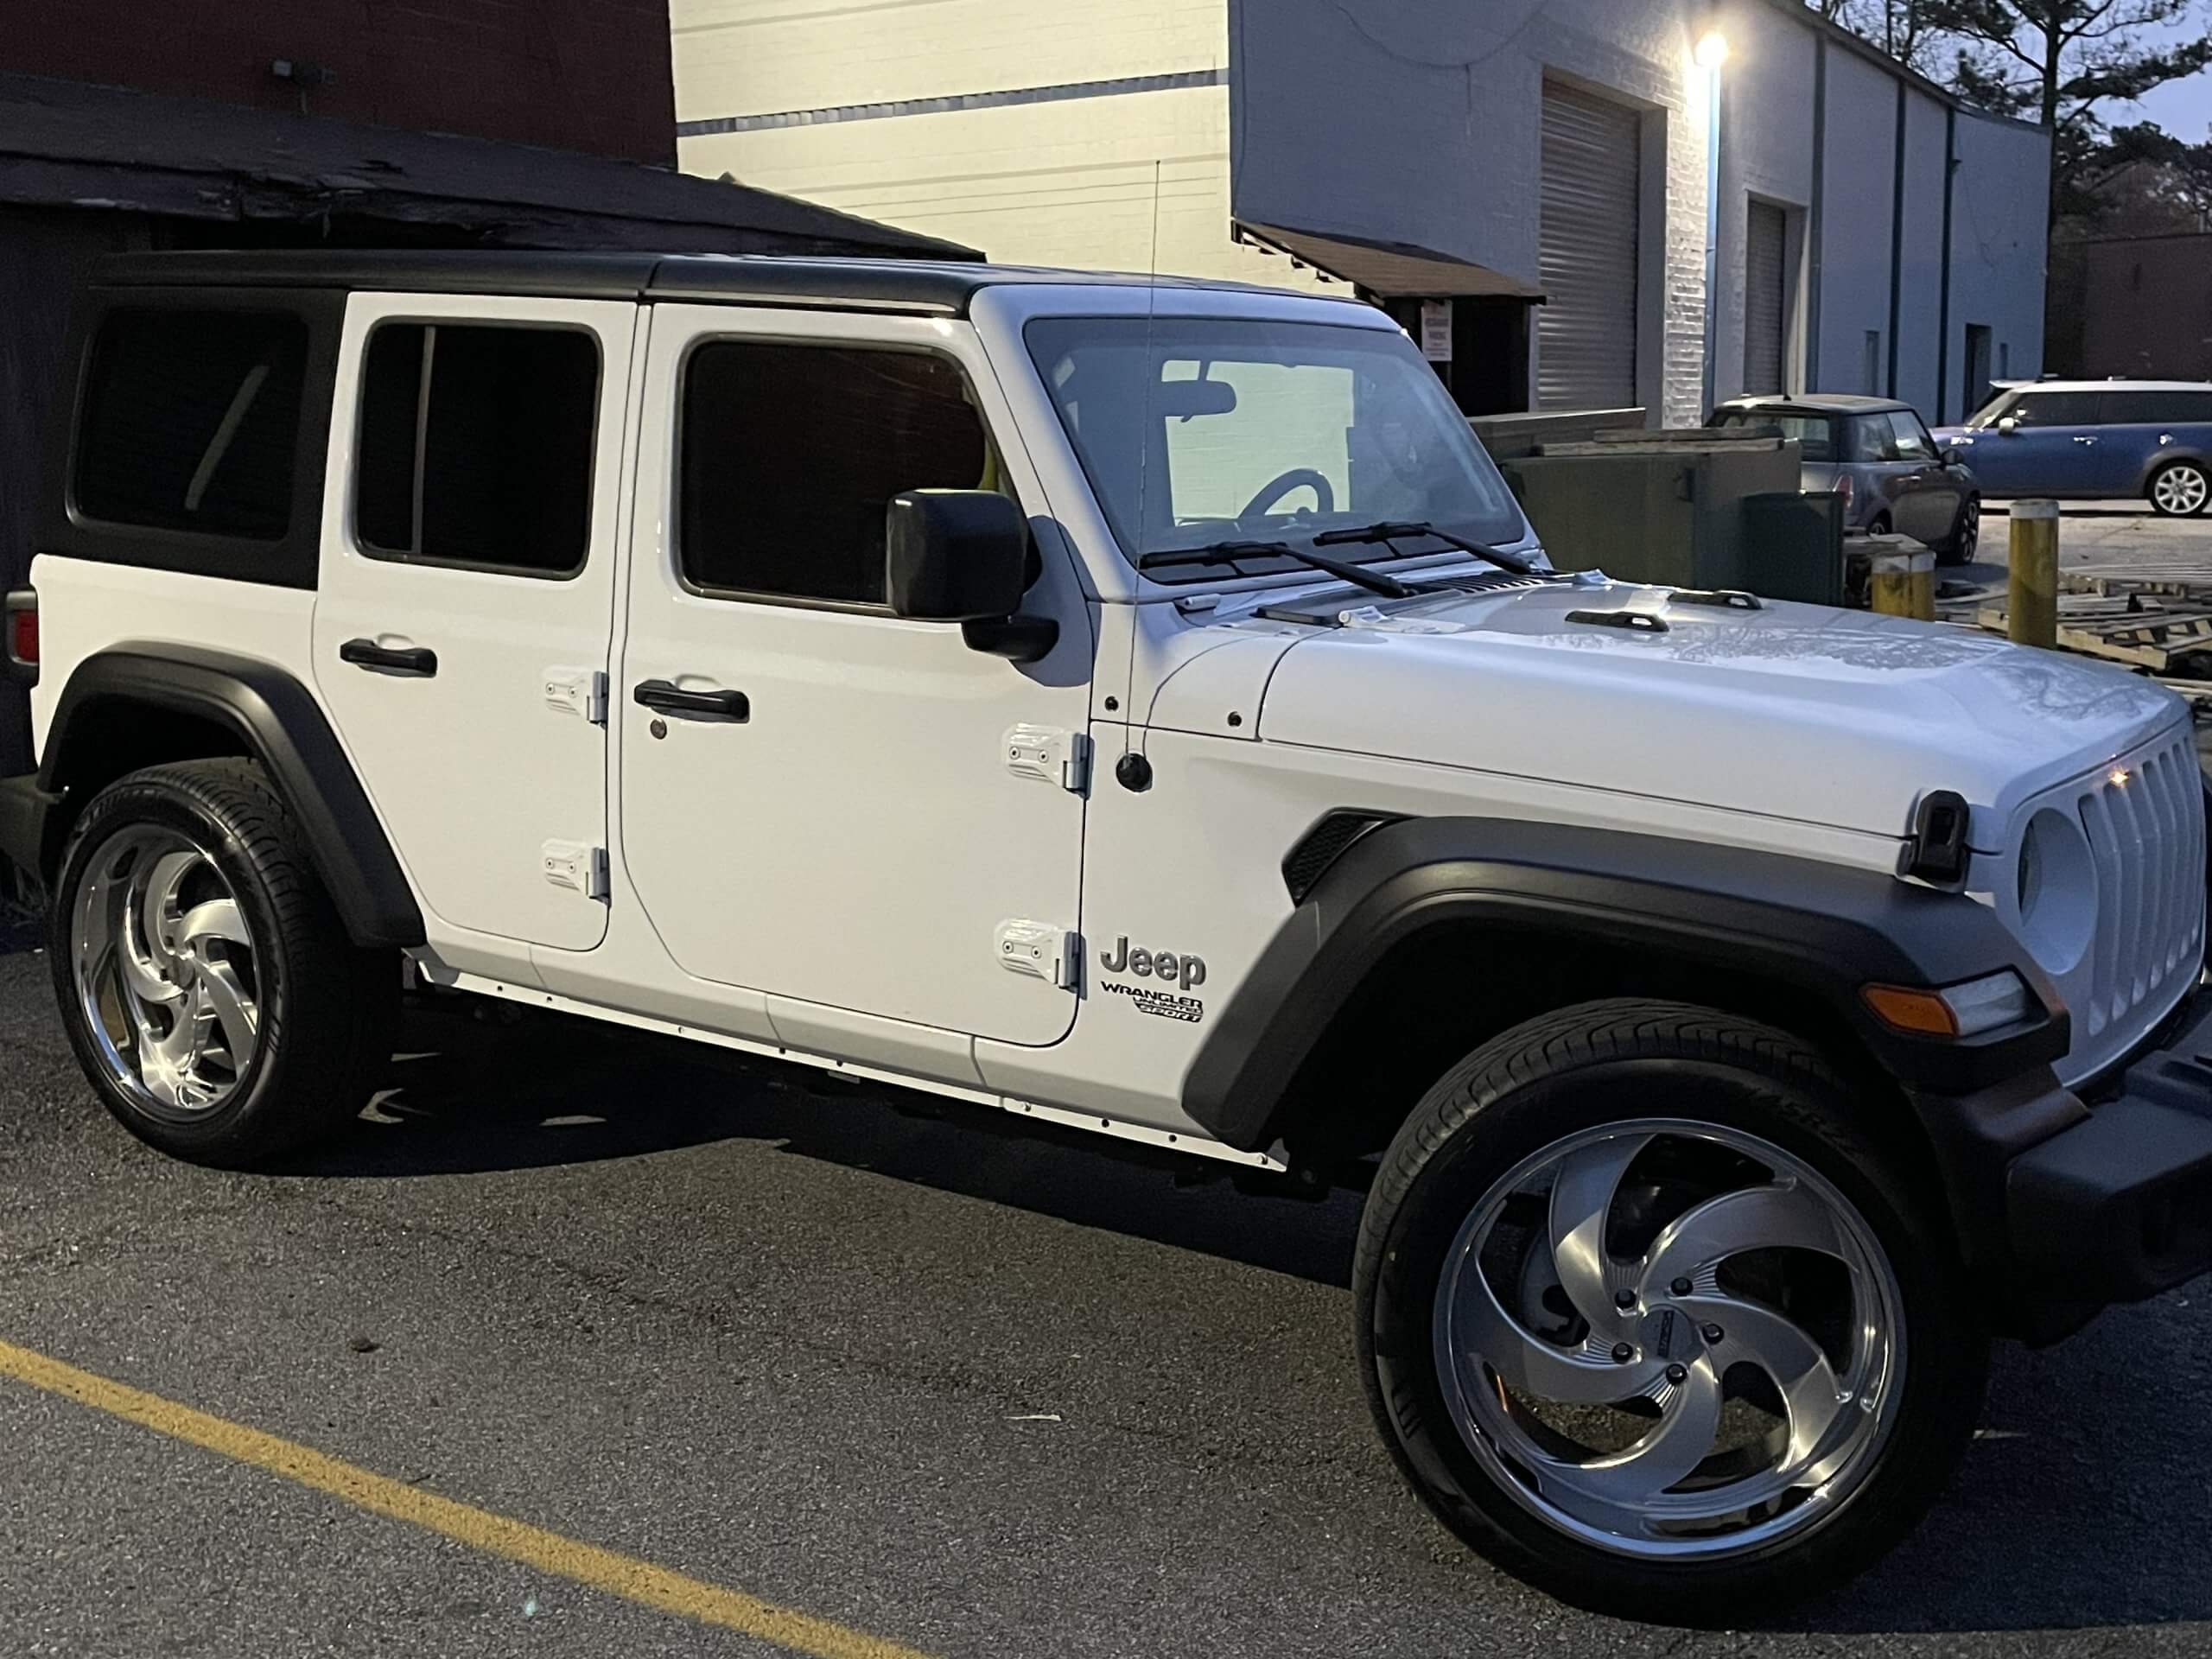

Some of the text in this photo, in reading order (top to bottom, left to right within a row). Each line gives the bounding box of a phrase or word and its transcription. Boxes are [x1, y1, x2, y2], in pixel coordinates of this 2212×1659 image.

[1101, 936, 1206, 990] Jeep
[1101, 981, 1202, 1007] WRANGLER
[1139, 1003, 1202, 1021] SPORT
